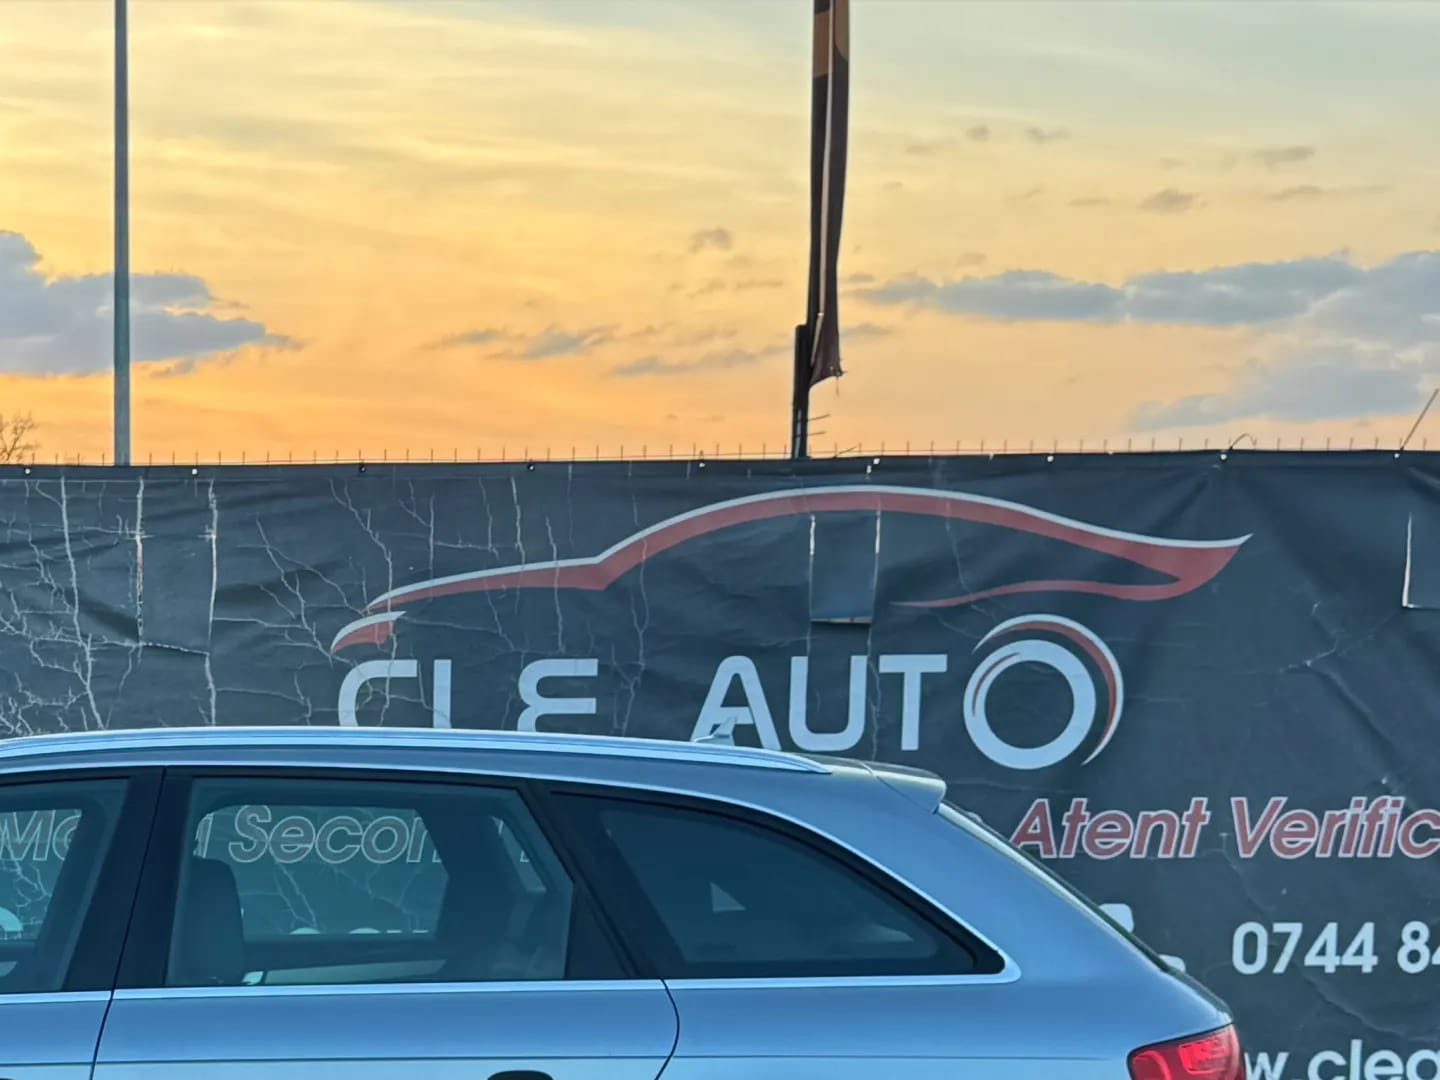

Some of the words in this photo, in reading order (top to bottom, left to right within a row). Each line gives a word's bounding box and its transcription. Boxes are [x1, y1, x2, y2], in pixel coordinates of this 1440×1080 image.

[690, 640, 1097, 770] AUTO
[1010, 797, 1211, 860] Atent
[1232, 921, 1378, 974] 0744
[1397, 920, 1440, 975] 8
